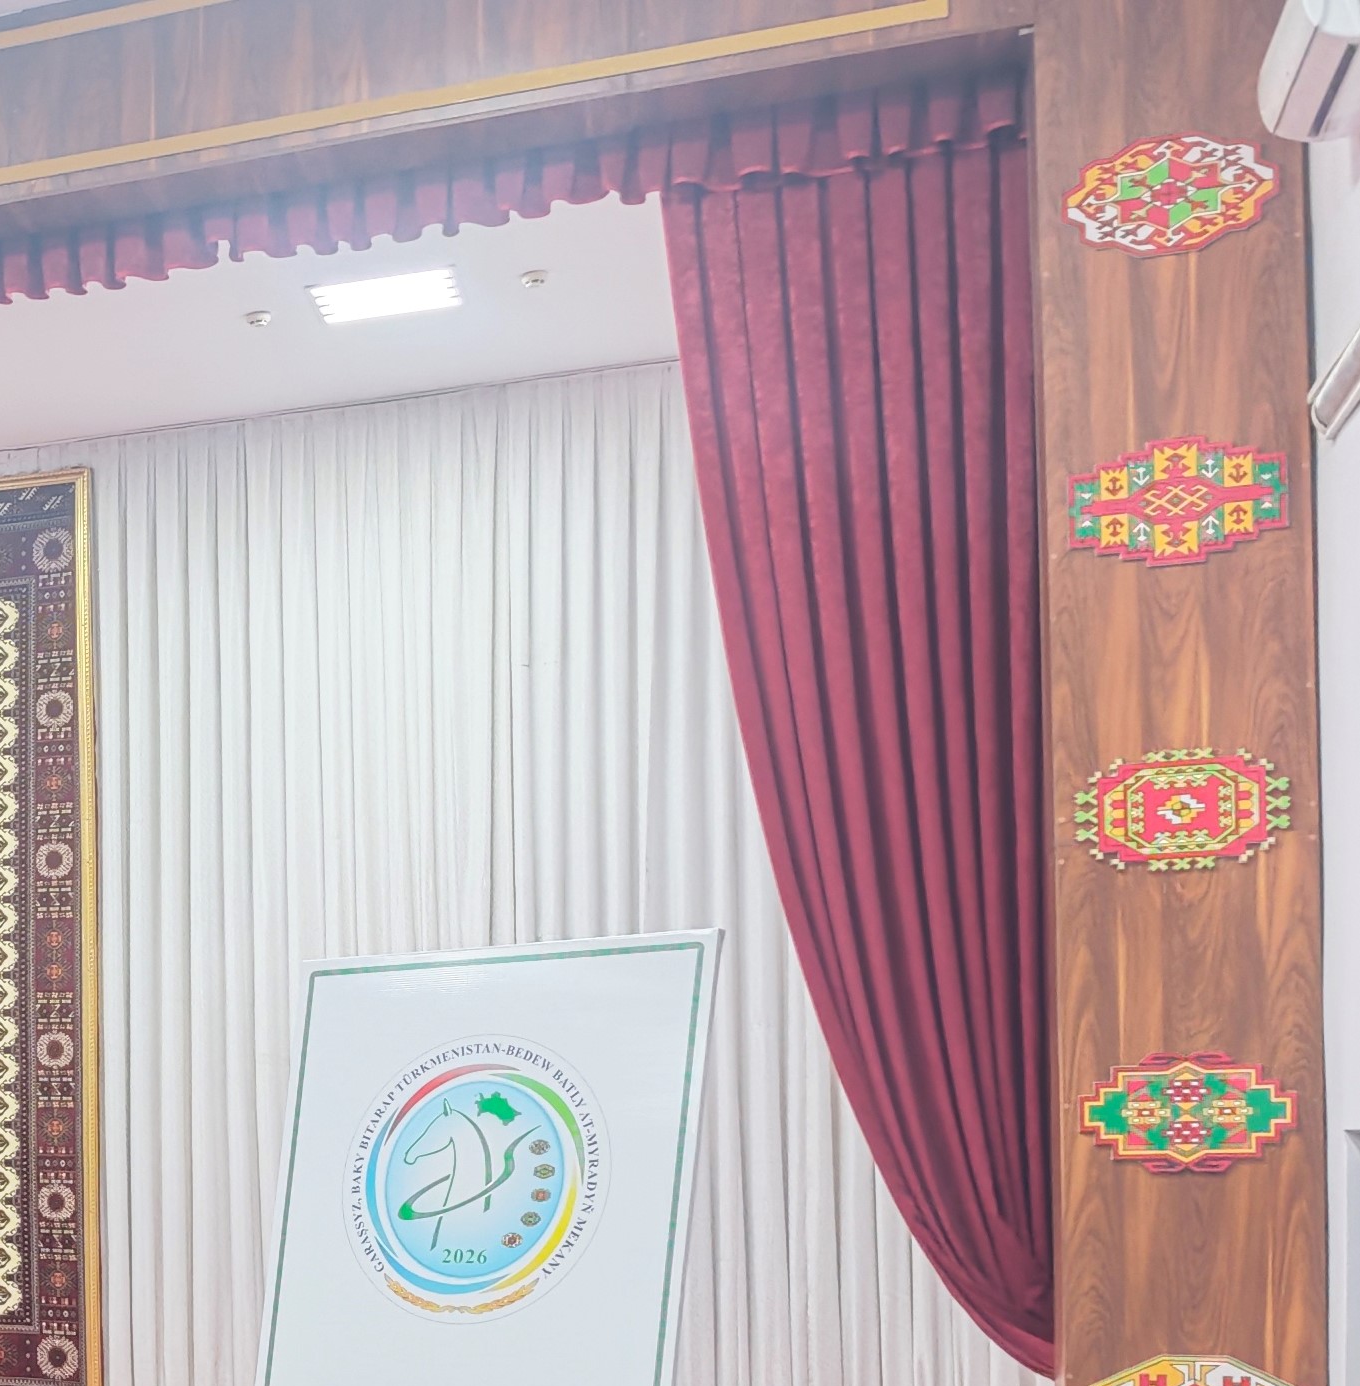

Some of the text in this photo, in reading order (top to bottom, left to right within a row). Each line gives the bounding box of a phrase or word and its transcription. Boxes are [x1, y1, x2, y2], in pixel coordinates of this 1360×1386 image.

[552, 1069, 587, 1108] BATLY
[359, 1091, 396, 1150] BITARAP
[351, 1153, 365, 1194] BAKY
[442, 1248, 488, 1265] 2026
[541, 1217, 588, 1280] MEKANY
